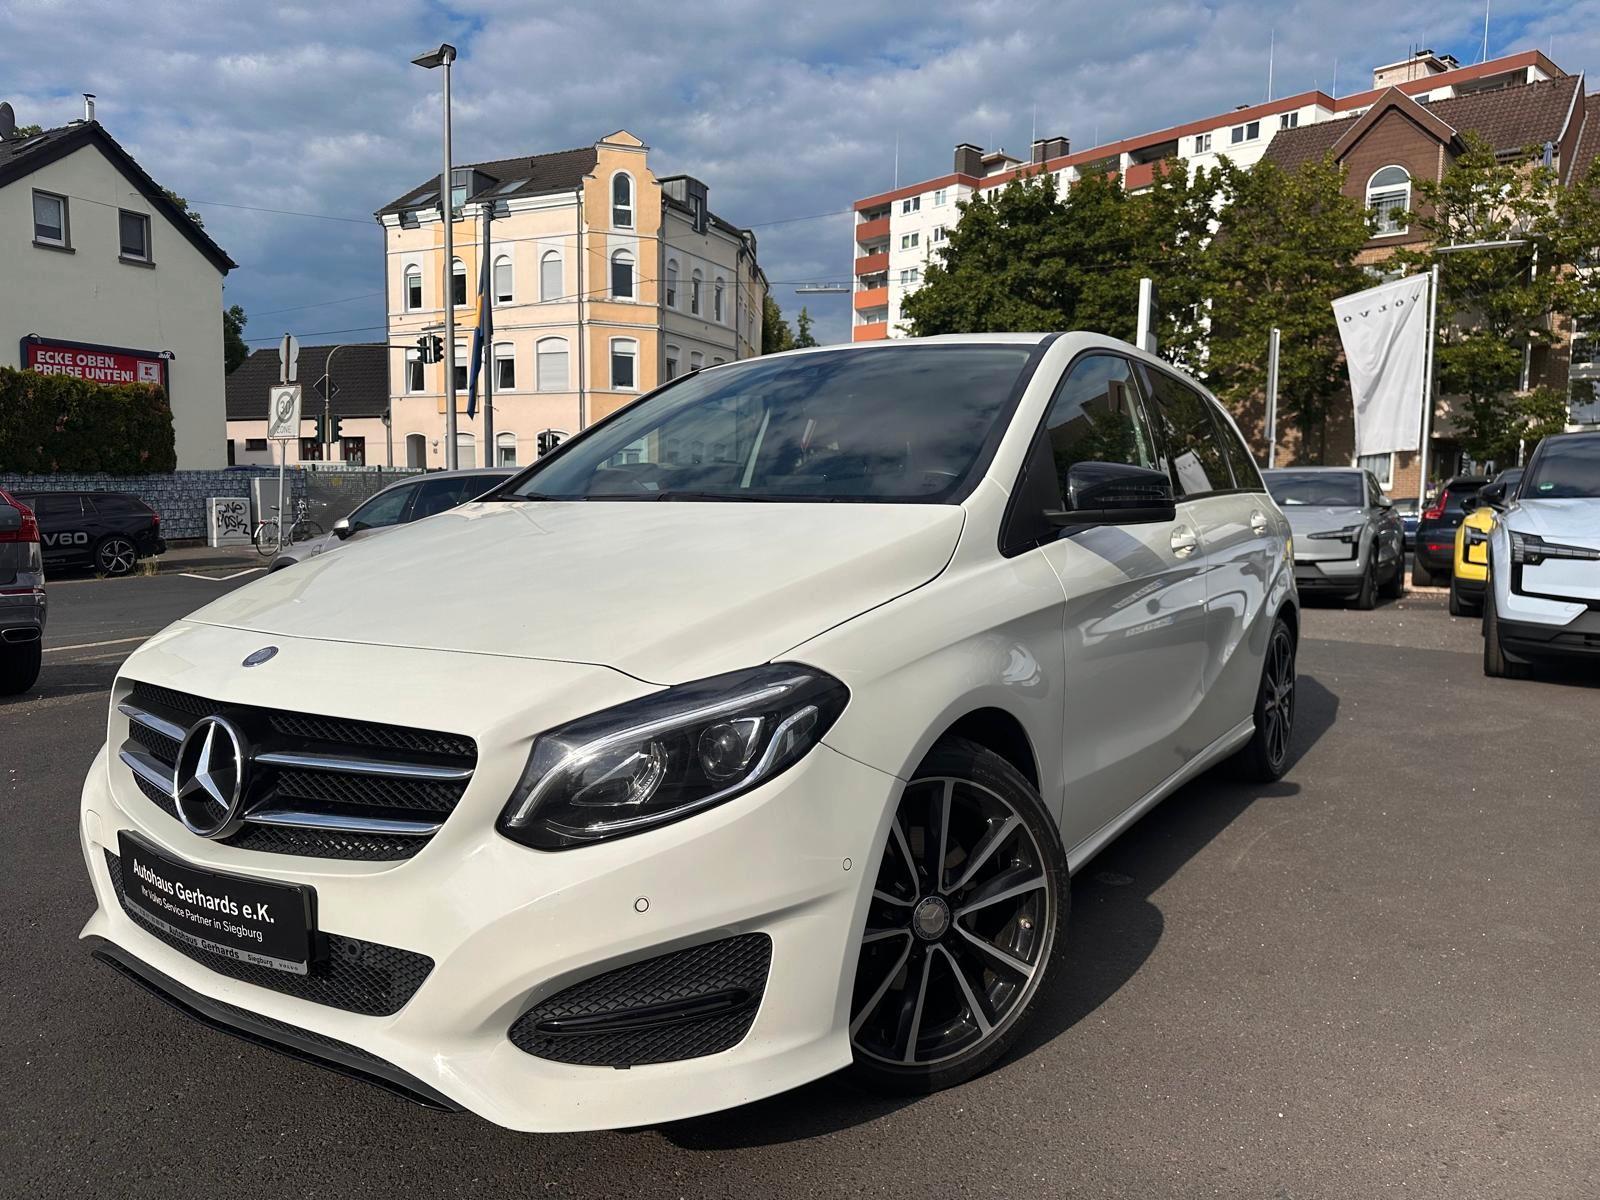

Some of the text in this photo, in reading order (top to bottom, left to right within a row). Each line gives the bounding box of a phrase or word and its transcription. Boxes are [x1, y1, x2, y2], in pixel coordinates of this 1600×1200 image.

[36, 350, 118, 369] ECKE OBEN.
[85, 368, 134, 382] UNTEN!
[280, 400, 291, 415] 30
[276, 425, 292, 434] ZONE
[42, 532, 88, 546] V60
[133, 858, 175, 896] Autohaus
[175, 882, 239, 916] Gerhards
[242, 903, 275, 924] e.K.
[148, 889, 163, 906] Volvo
[163, 897, 185, 917] Service
[185, 908, 212, 927] Partner
[213, 918, 222, 930] in
[223, 920, 263, 943] Siegburg
[168, 926, 299, 971] Autohaus Gerhards Siegburg VOLVO
